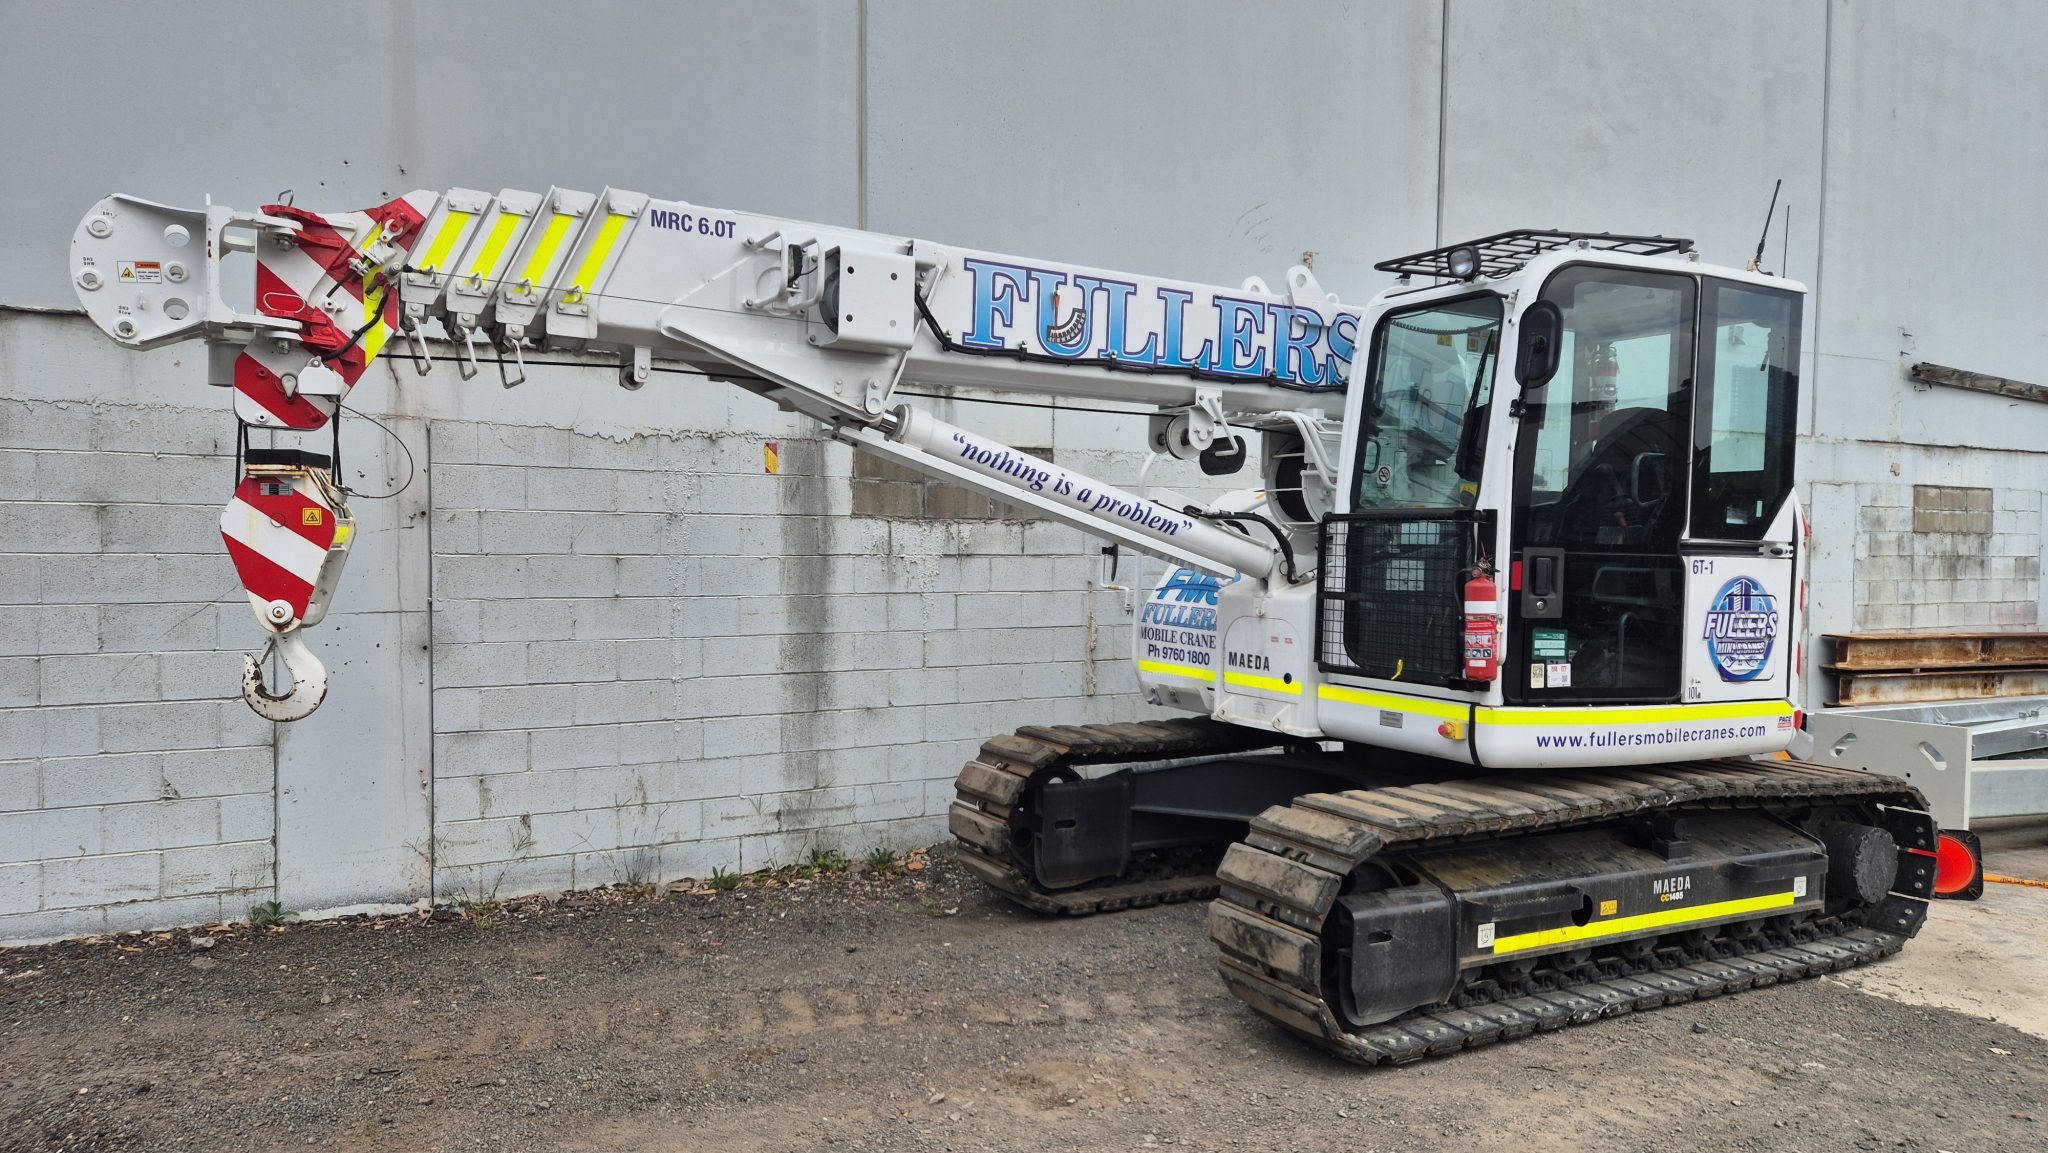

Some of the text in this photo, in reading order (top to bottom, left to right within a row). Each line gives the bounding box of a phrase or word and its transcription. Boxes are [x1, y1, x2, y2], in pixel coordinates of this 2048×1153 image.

[651, 209, 736, 239] MRC 6.0T
[962, 257, 1361, 387] FULLERS
[1053, 473, 1074, 496] is
[1077, 488, 1093, 503] a
[1692, 560, 1714, 575] 6T-1
[1141, 602, 1218, 632] FULLER
[1703, 610, 1778, 640] FULLERS
[1140, 626, 1178, 644] MOBILE
[1147, 643, 1210, 666] Ph 9760 1800
[1228, 651, 1270, 672] MAEDA
[1778, 715, 1792, 723] PACE
[1536, 723, 1766, 748] www.fullersmobilecranes.com
[1653, 875, 1691, 895] MAEDA
